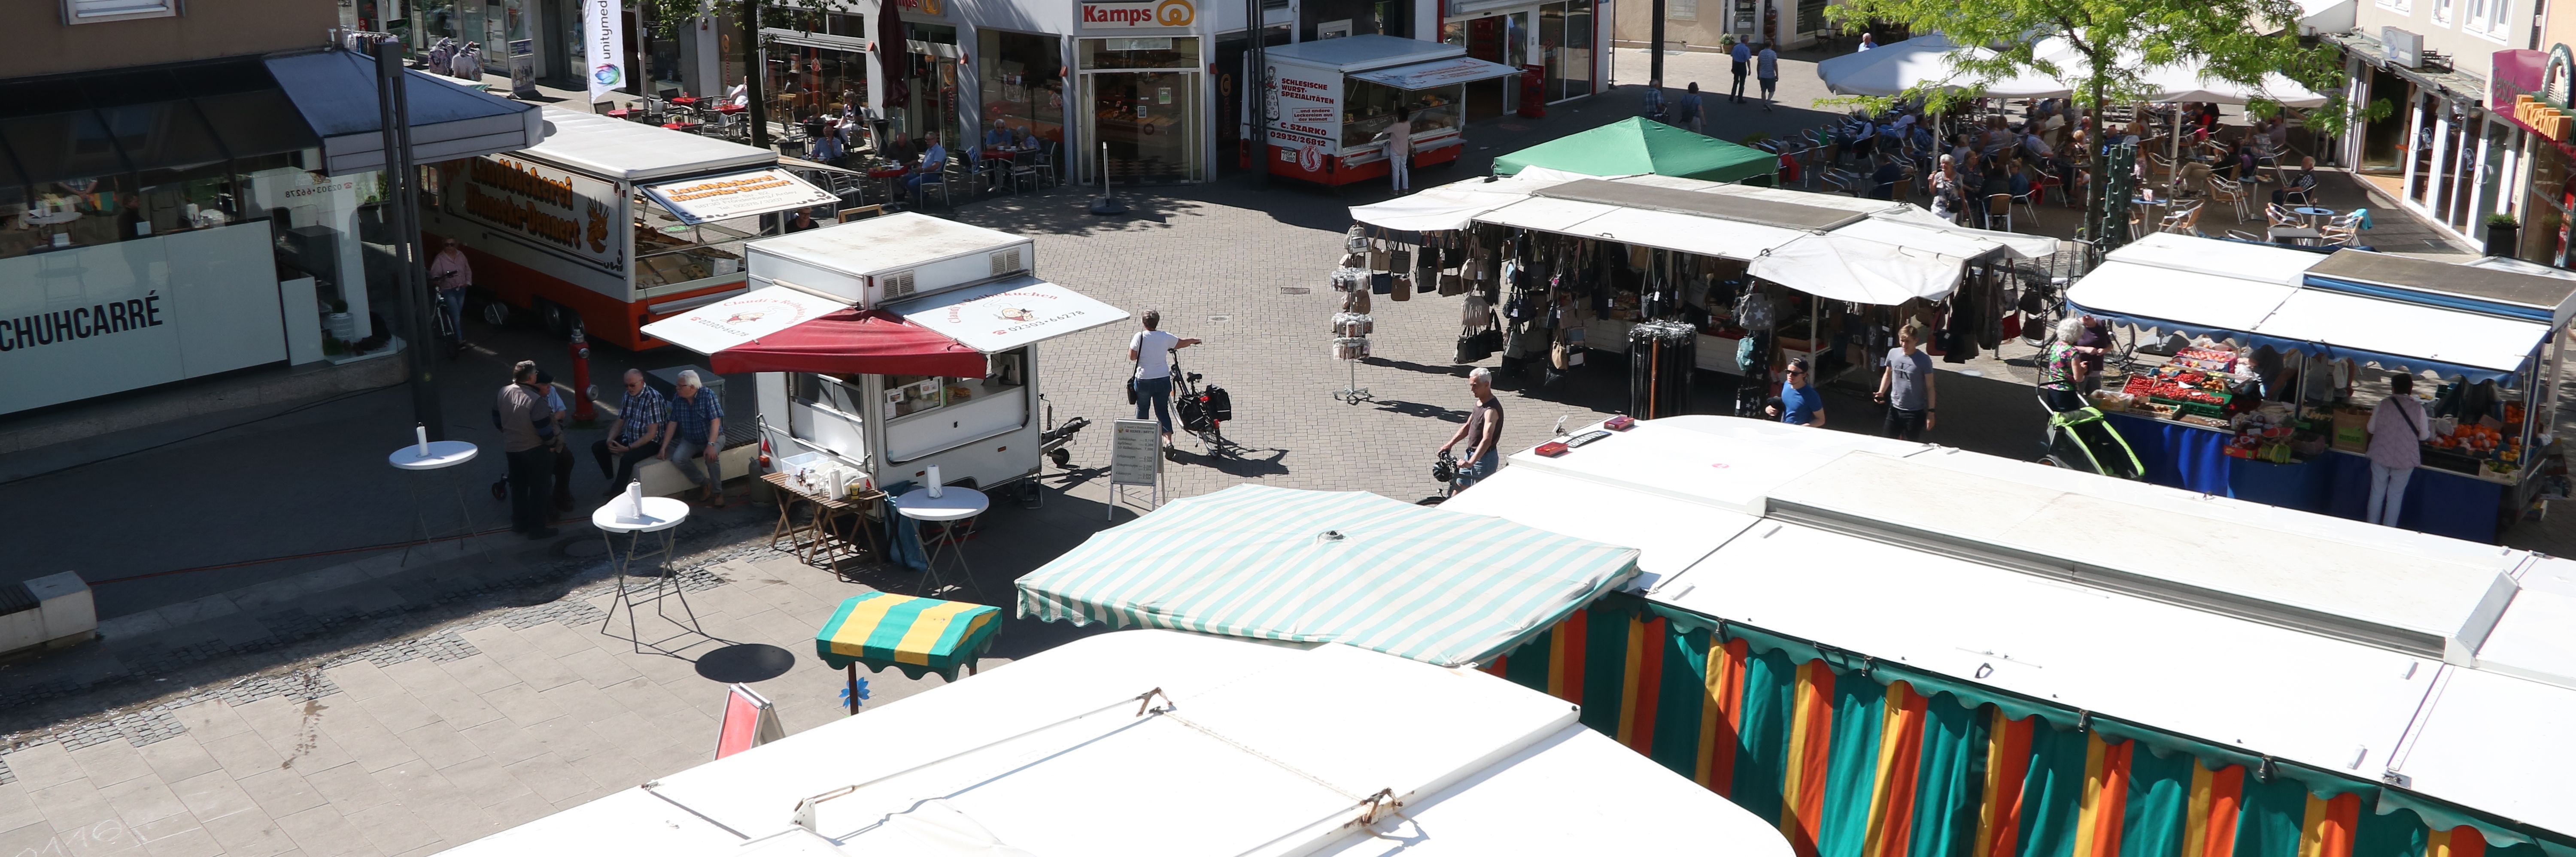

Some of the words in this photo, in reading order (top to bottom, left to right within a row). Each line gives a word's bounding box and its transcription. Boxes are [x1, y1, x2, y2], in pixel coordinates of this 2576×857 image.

[1083, 5, 1152, 26] Kamps
[1282, 78, 1327, 90] SCHLESISCHE
[1282, 85, 1307, 93] WURST-
[1281, 91, 1334, 104] SPEZIALITÄTEN
[2513, 94, 2562, 141] Hackethal
[1270, 131, 1326, 147] 02932/26812
[1290, 124, 1327, 136] SZARKO
[471, 158, 573, 211] Landbäckerei
[666, 175, 778, 195] Landbäckerei
[668, 179, 794, 202] Hönnecke-Deunert
[465, 182, 581, 250] Hönnecke-Deunert
[963, 291, 1058, 303] Reibekuchen
[781, 300, 808, 324] Reibekuchen
